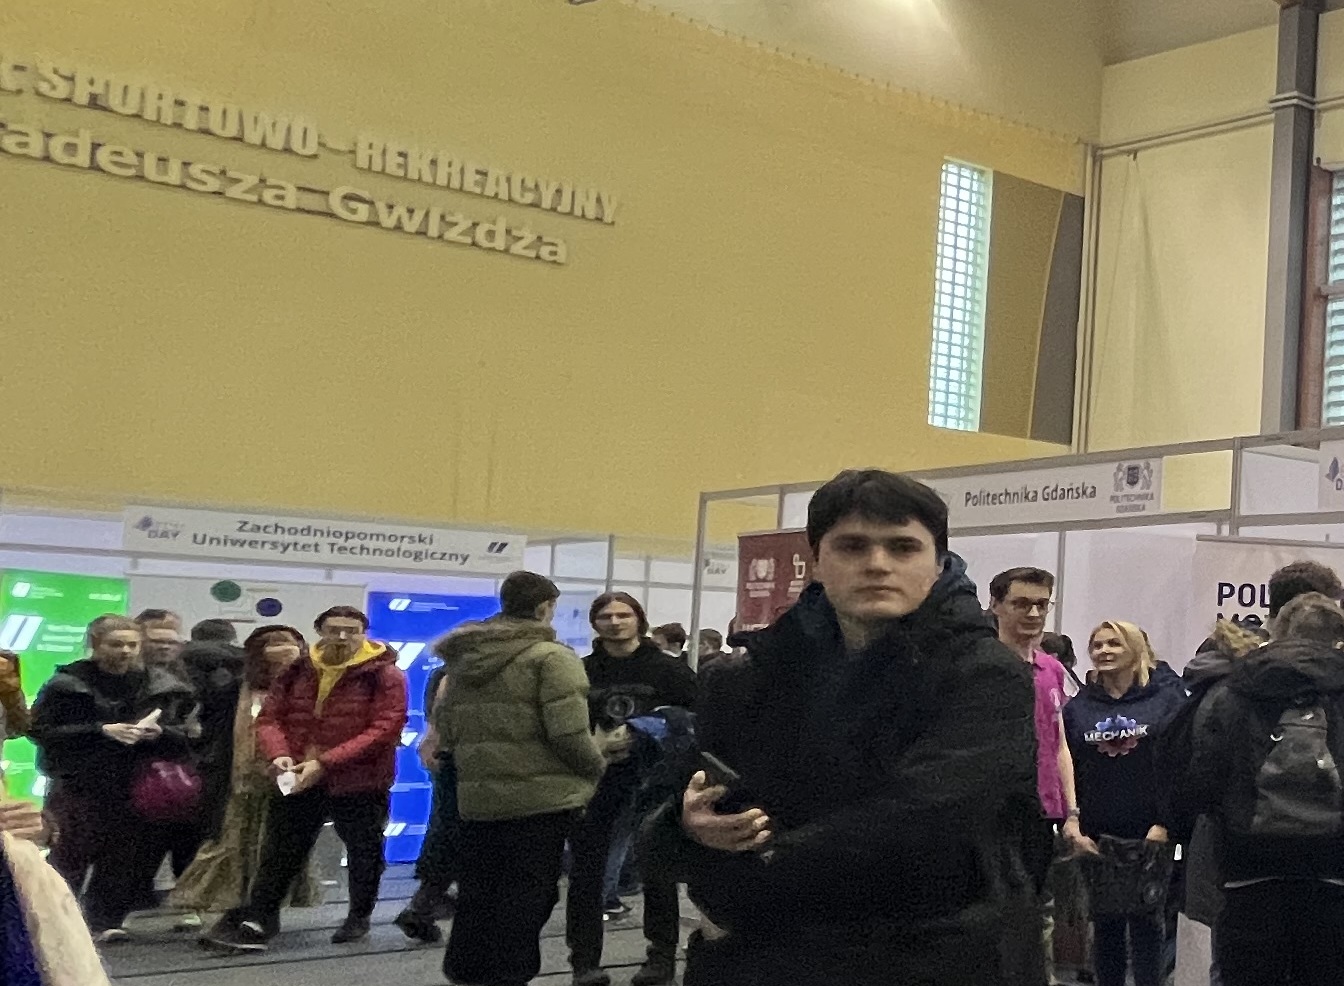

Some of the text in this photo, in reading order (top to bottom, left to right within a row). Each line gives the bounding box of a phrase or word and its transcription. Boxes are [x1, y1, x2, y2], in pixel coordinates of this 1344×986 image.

[0, 118, 298, 210] adeusza
[965, 482, 1097, 507] Politechnika Gdańska
[236, 519, 435, 547] Zachodniopomorski
[192, 533, 470, 565] Uniwersytet Technologiczny
